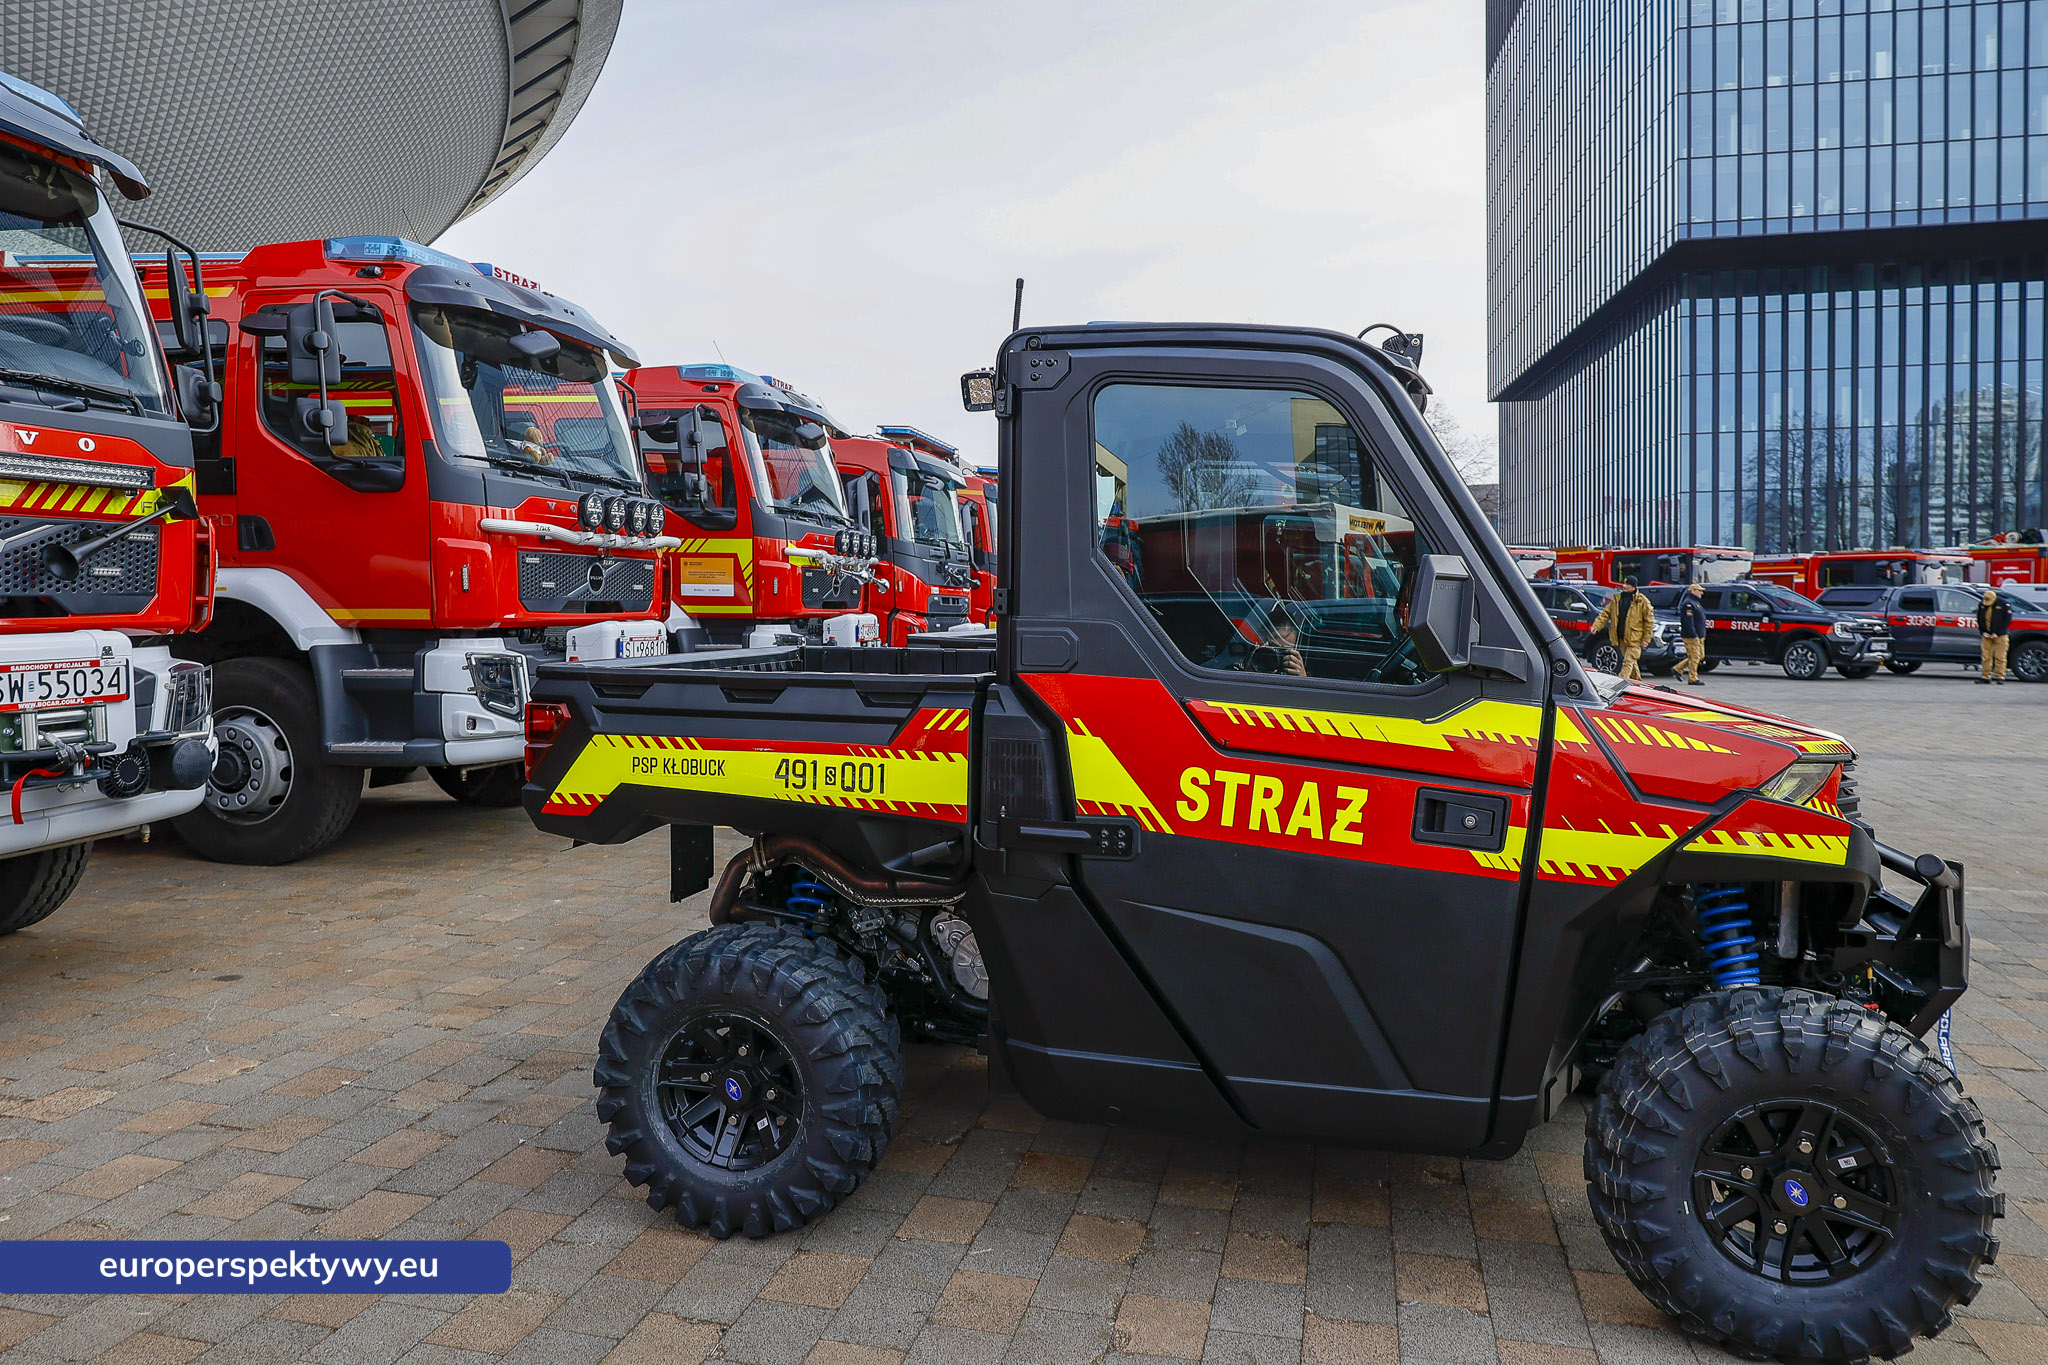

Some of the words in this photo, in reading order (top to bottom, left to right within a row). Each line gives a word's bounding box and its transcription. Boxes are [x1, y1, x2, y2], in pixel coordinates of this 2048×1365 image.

[10, 664, 53, 672] SAMOCHODY
[54, 661, 91, 669] SPECJALNE
[38, 667, 121, 700] 55034
[18, 698, 85, 709] WWW.BOCAR.COM.PL
[632, 756, 658, 774] PSP
[663, 757, 726, 777] KŁOBUCK
